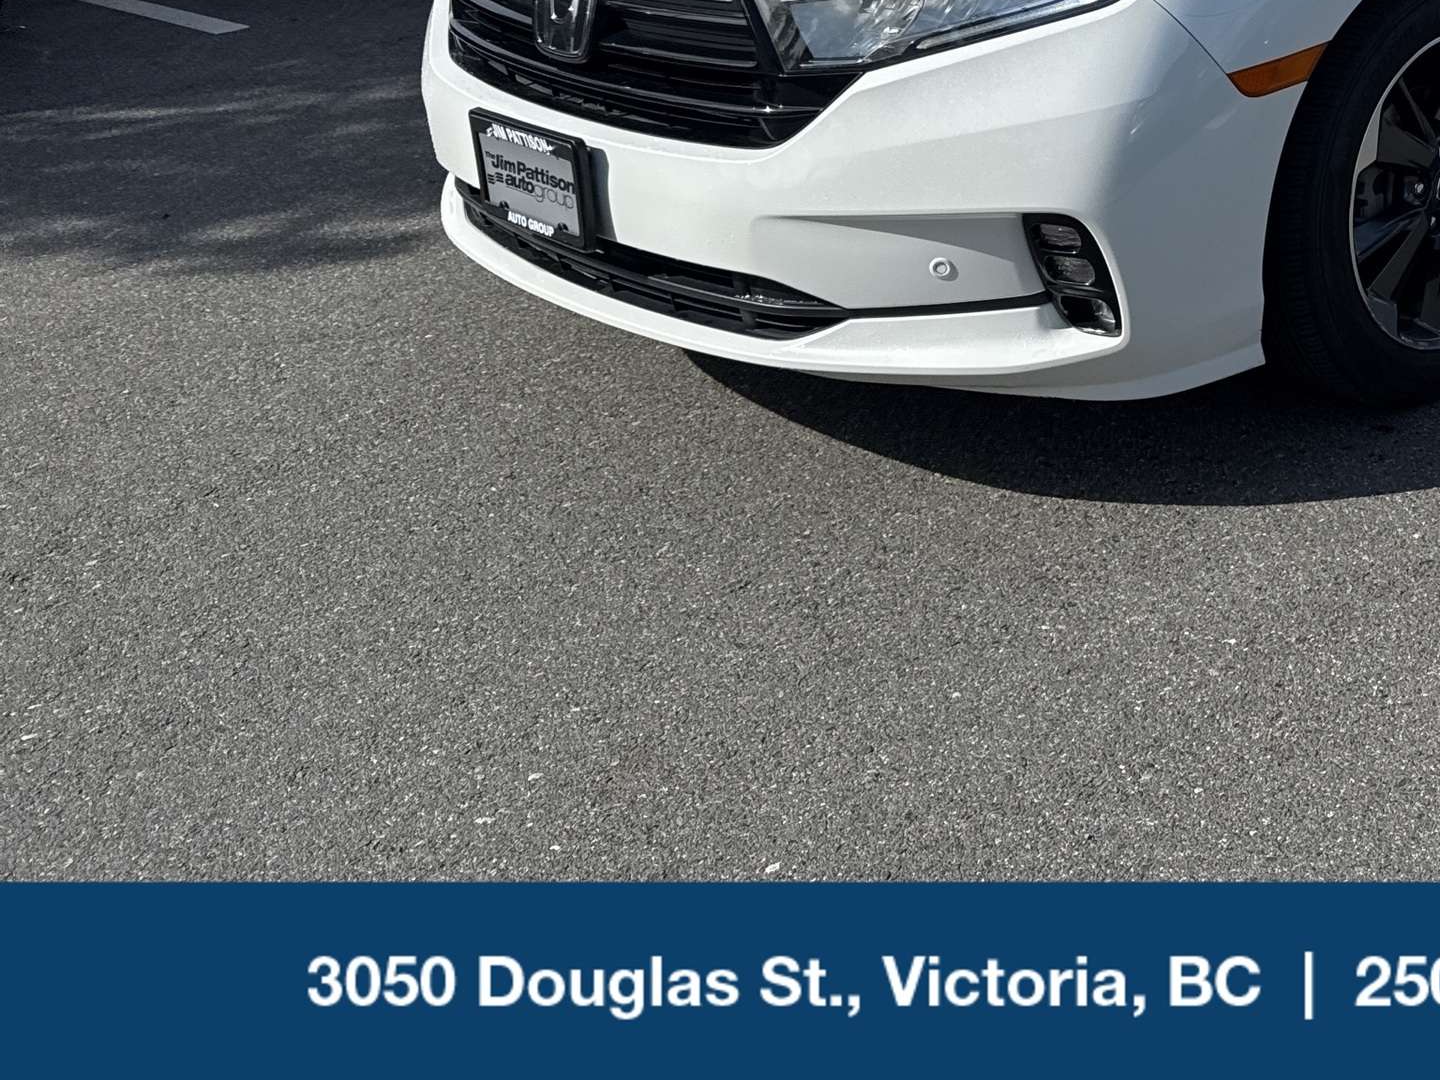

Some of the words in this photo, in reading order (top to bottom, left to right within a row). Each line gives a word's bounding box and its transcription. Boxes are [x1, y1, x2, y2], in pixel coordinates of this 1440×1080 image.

[492, 123, 508, 141] JIM
[508, 128, 549, 153] PATTISON
[507, 210, 527, 228] AUTO
[527, 218, 555, 237] GROUP
